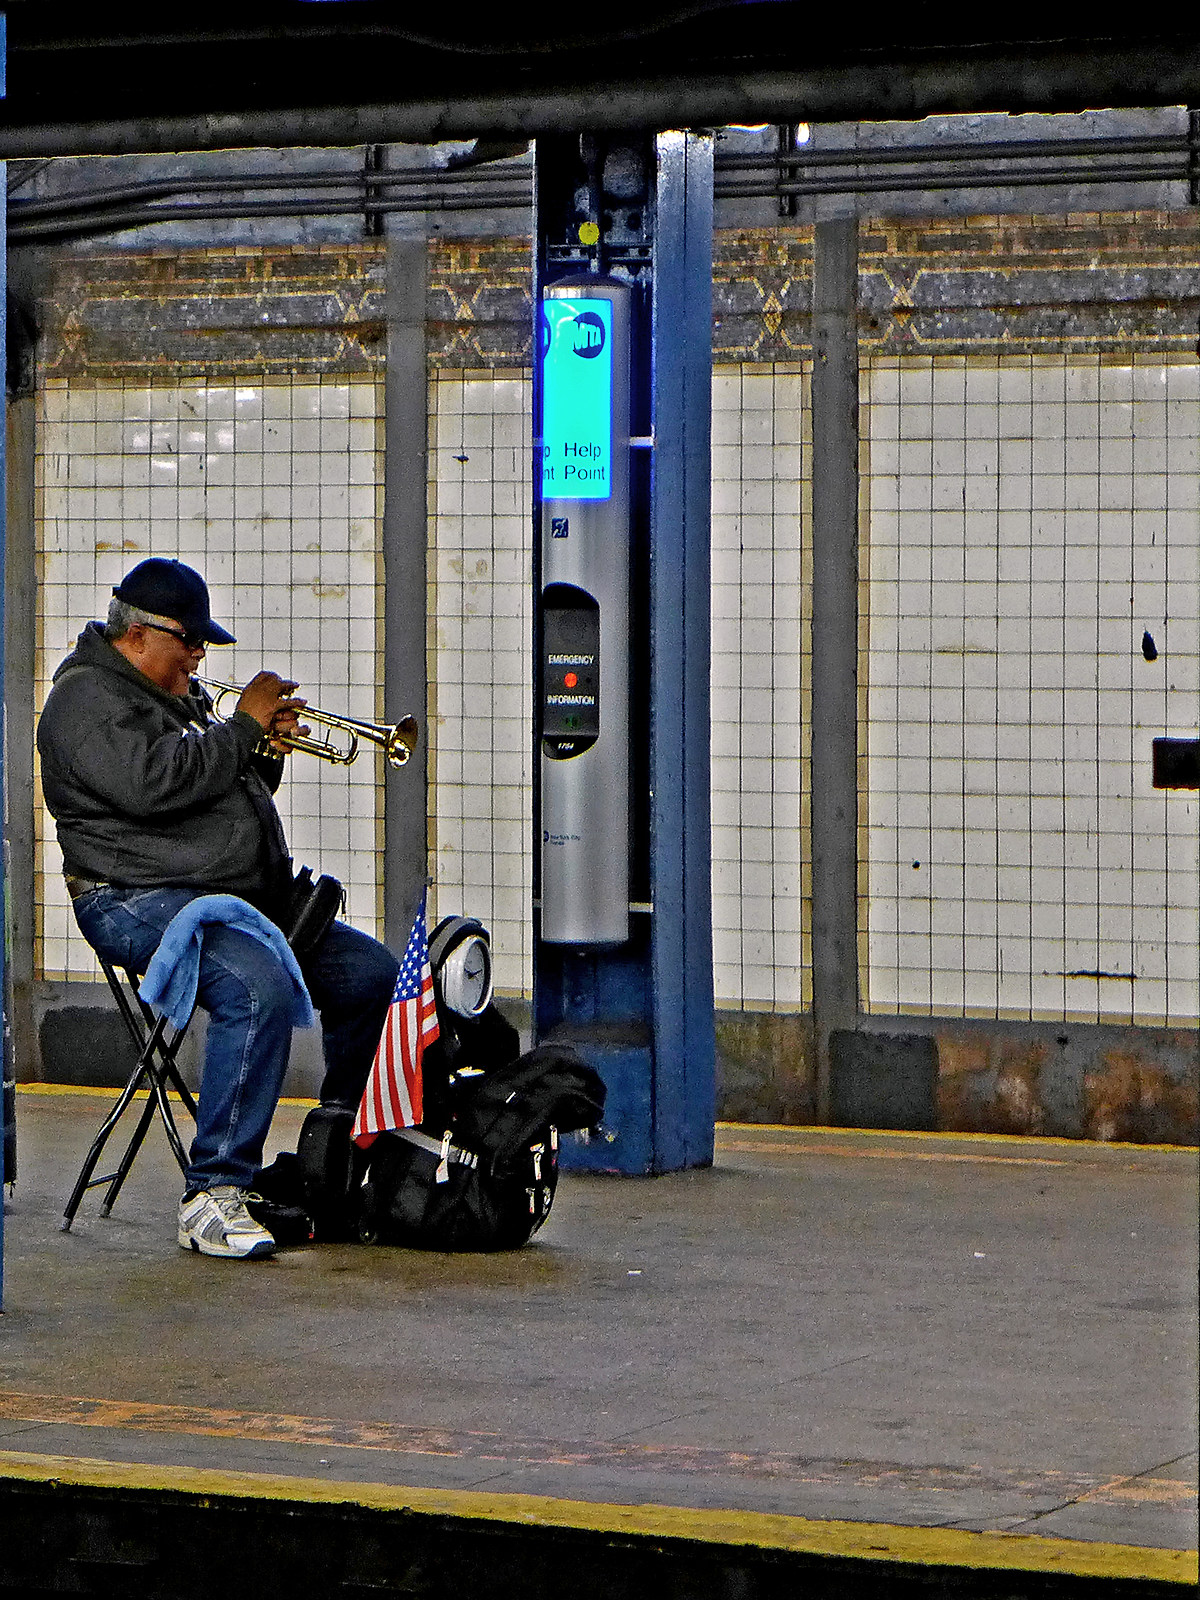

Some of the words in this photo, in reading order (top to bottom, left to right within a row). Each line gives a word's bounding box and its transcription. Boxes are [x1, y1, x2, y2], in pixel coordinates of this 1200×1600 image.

[564, 442, 601, 461] Help
[564, 464, 605, 480] Point
[548, 654, 594, 665] EMERGENCY
[547, 695, 595, 705] INFORMATION
